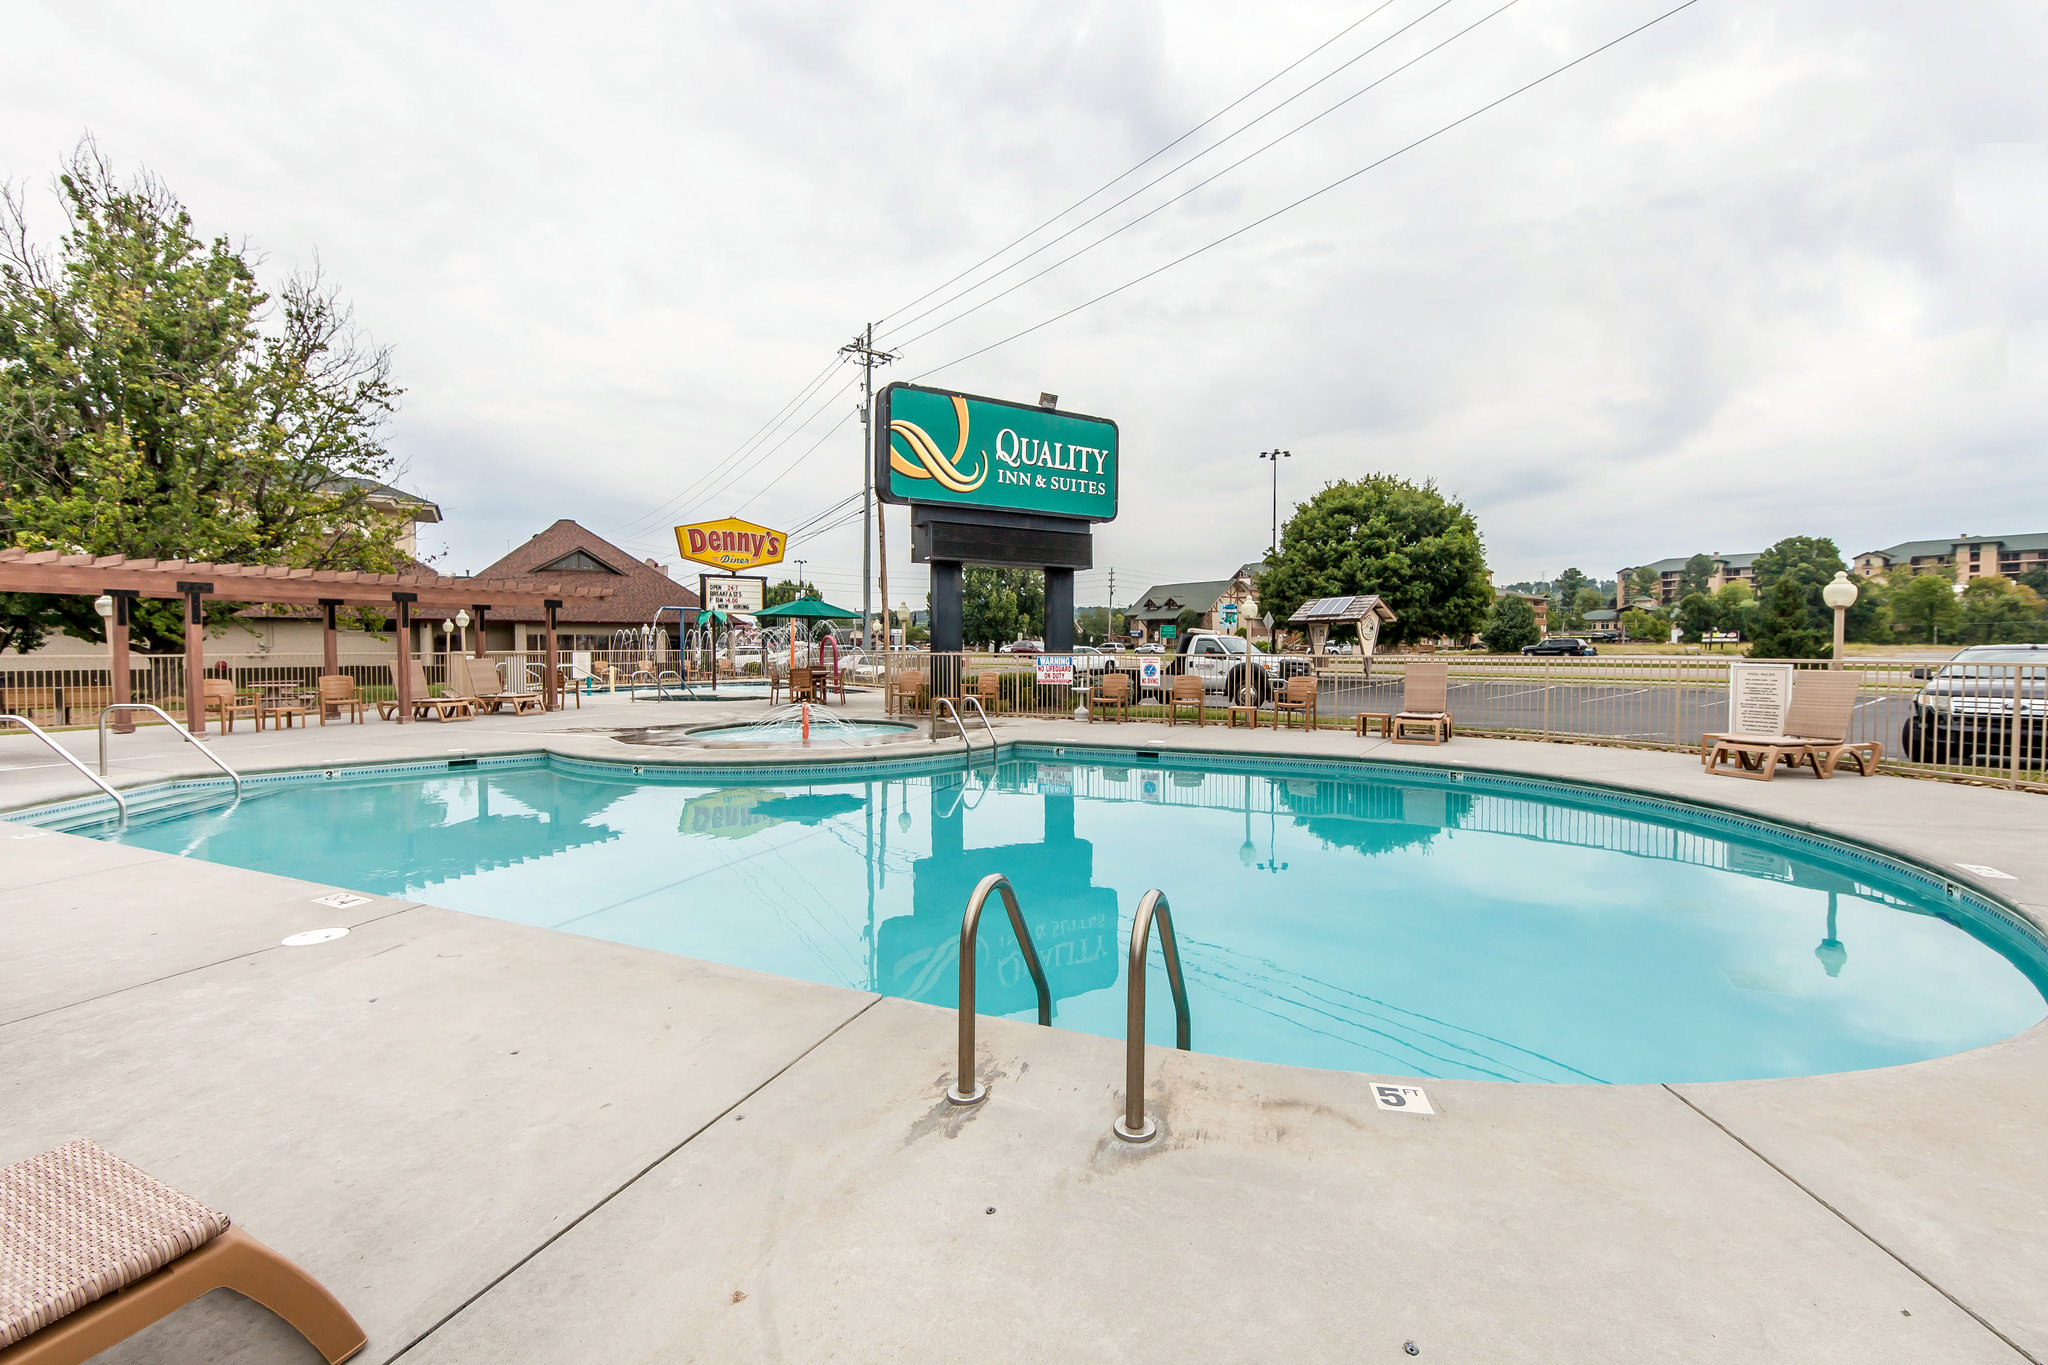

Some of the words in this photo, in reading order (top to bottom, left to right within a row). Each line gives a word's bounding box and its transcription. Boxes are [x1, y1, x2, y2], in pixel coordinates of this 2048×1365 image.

[995, 428, 1109, 475] QUALITY
[998, 469, 1031, 487] INN
[1035, 474, 1047, 489] &
[1051, 476, 1106, 496] SUITES
[687, 528, 780, 558] Denny's
[720, 555, 750, 564] Diner
[1039, 656, 1070, 665] WARNING
[1376, 1086, 1406, 1107] 5
[1402, 1088, 1419, 1097] FT
